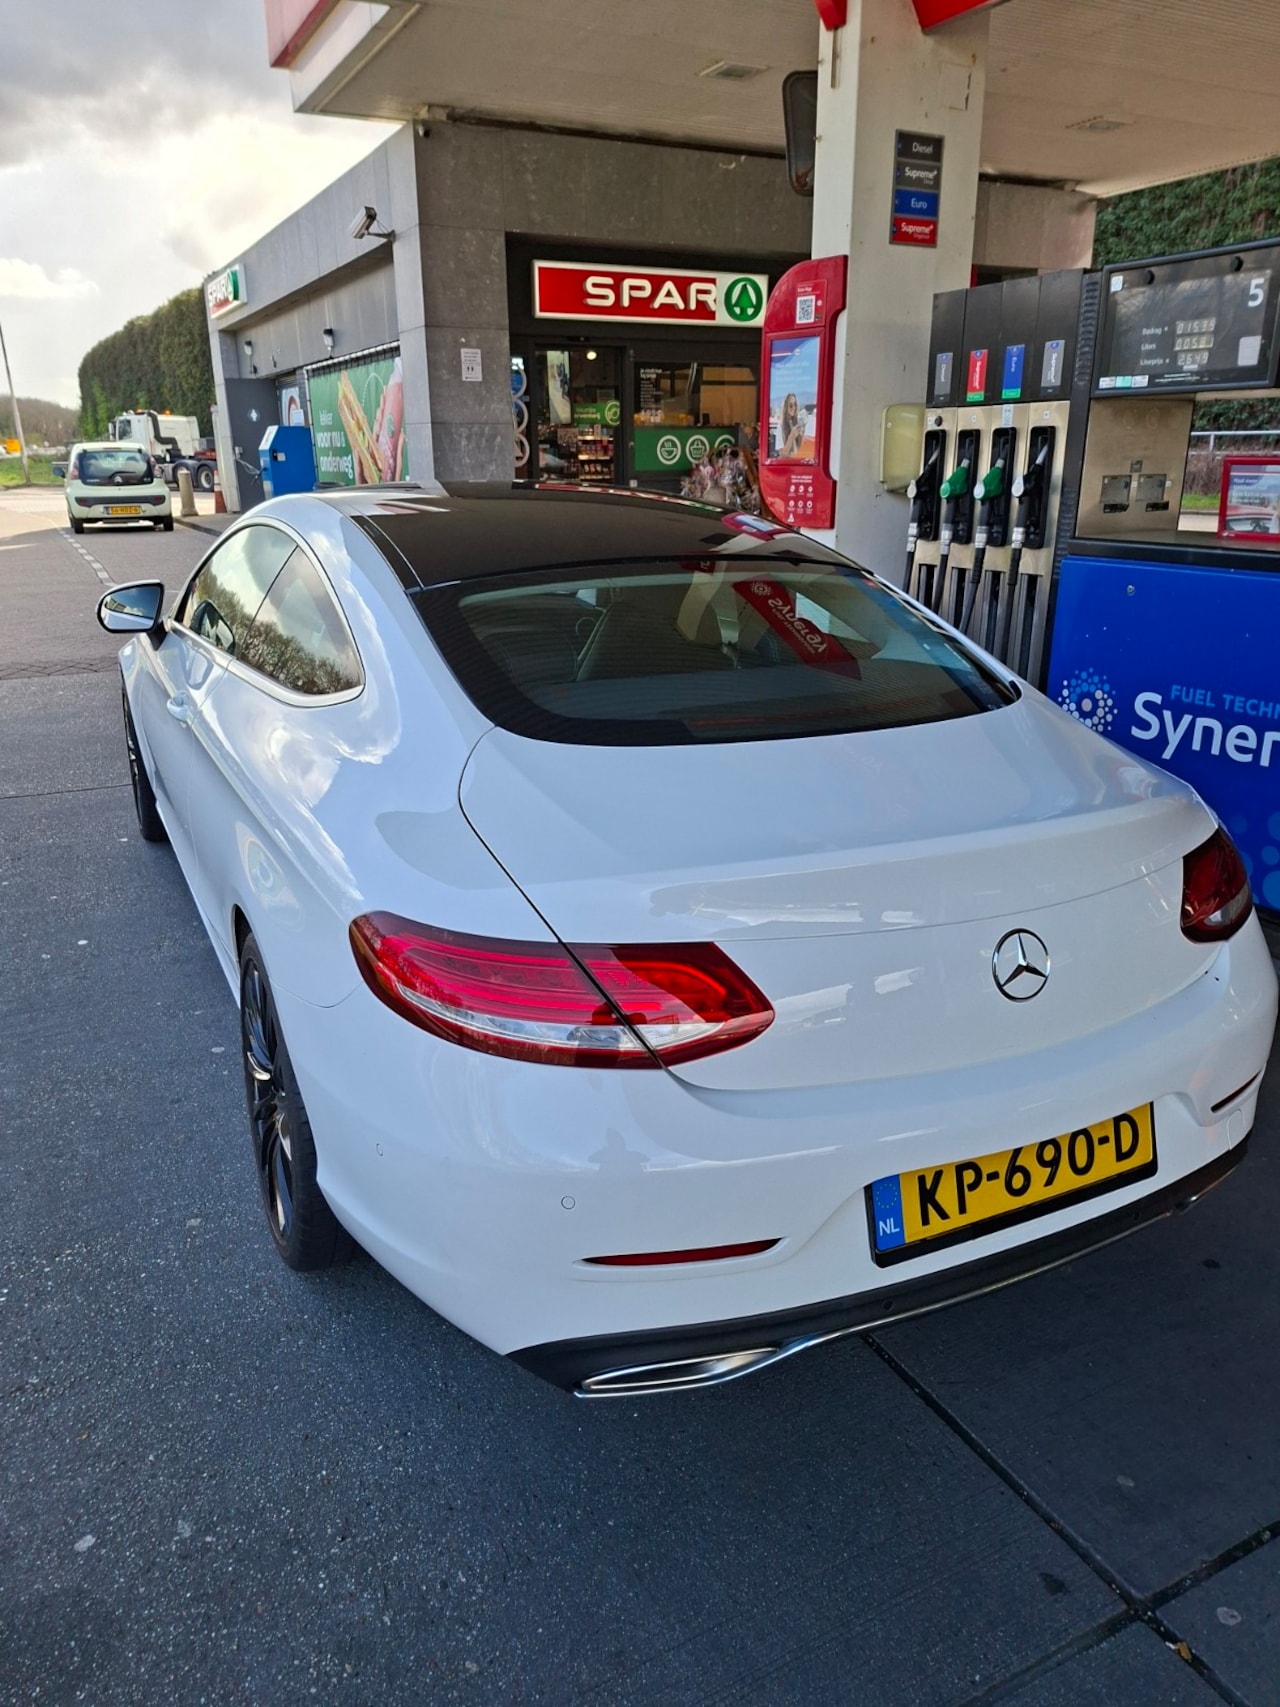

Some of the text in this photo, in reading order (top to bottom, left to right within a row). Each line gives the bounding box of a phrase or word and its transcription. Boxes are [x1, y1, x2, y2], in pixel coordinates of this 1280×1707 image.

[912, 142, 934, 154] Diesel
[911, 198, 928, 209] Euro
[585, 276, 716, 311] SPAR
[1247, 278, 1265, 307] 5
[1010, 357, 1018, 372] Euro
[317, 431, 331, 448] voor
[320, 450, 353, 479] onderweg
[1171, 684, 1215, 707] FUEL
[1130, 691, 1280, 768] Syner
[917, 1113, 1140, 1227] KP-690-D
[879, 1217, 900, 1237] NL
